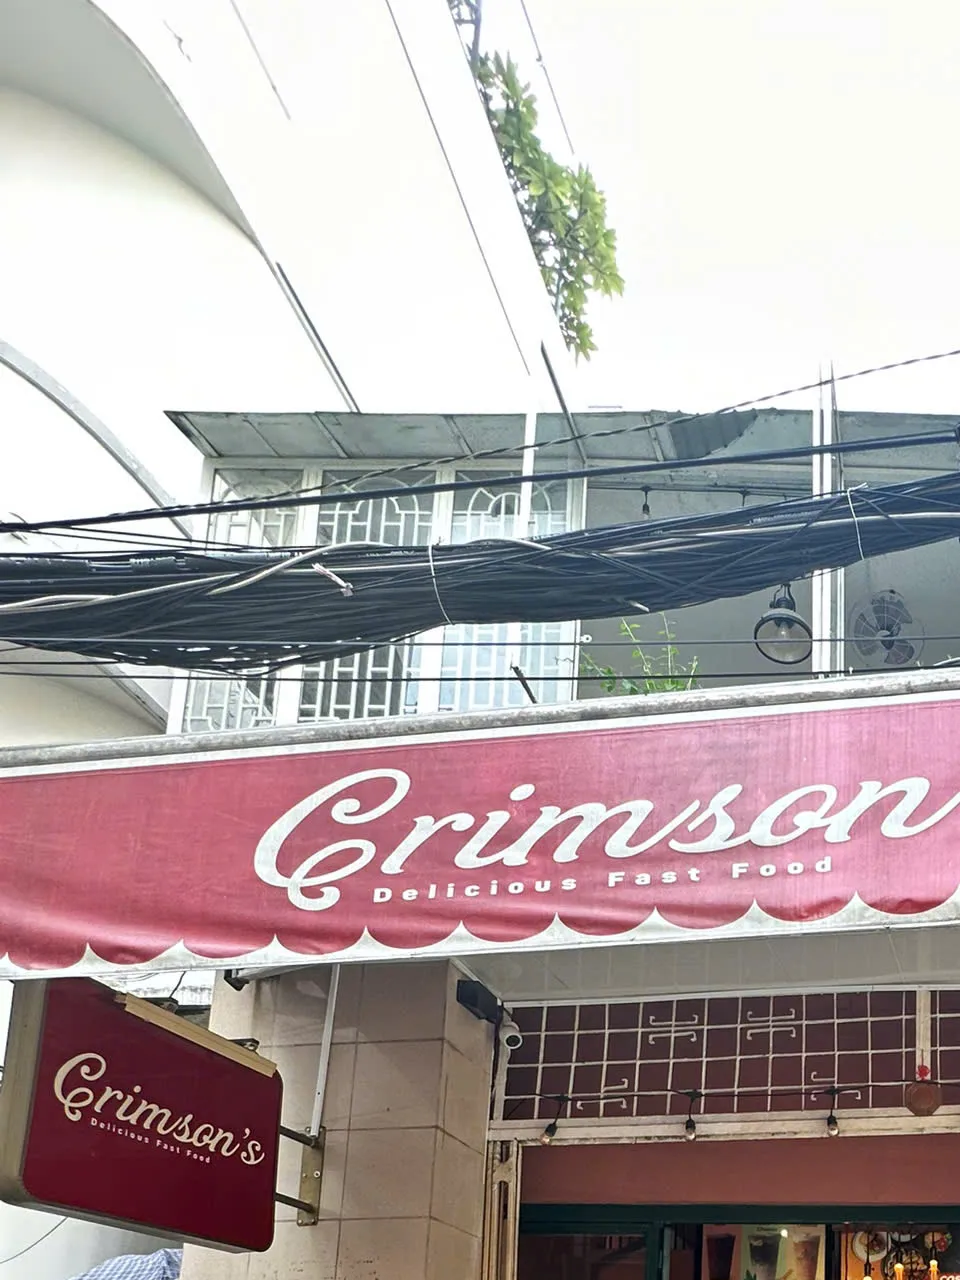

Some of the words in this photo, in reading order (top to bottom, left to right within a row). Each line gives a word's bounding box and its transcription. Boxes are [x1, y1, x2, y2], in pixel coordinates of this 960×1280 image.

[373, 876, 578, 903] Delicious
[608, 867, 700, 888] Fast
[732, 856, 832, 878] Food
[54, 1052, 265, 1165] Crimson's
[90, 1117, 150, 1144] Delicious
[156, 1139, 181, 1154] Fast
[186, 1149, 211, 1164] Food
